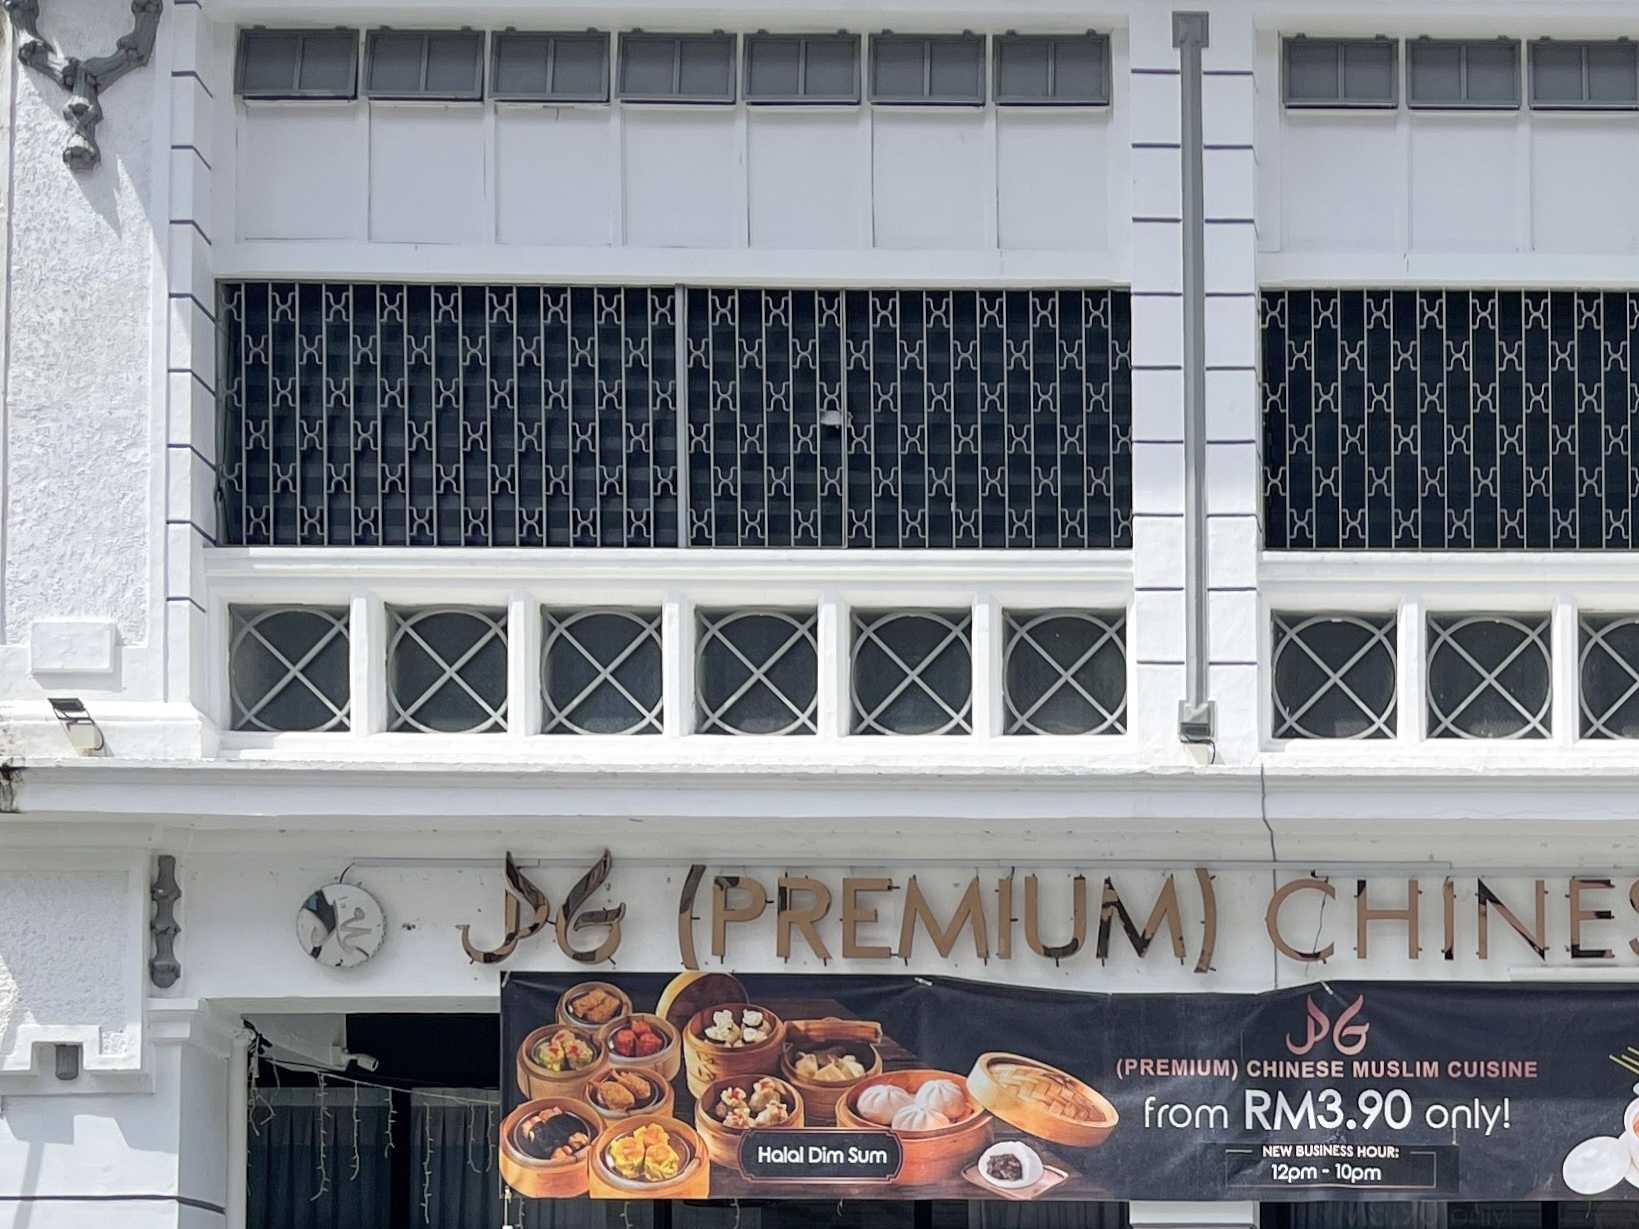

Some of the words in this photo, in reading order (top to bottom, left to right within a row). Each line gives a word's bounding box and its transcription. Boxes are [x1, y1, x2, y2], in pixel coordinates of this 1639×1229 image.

[678, 864, 1217, 974] (PREMIUM)
[1116, 1058, 1239, 1081] (PREMIUM)
[1246, 1060, 1345, 1079] CHINESE
[1352, 1060, 1440, 1079] MUSLIM
[1447, 1060, 1538, 1079] CUISINE
[1144, 1096, 1229, 1129] from
[1244, 1088, 1413, 1131] RM3.90
[1425, 1097, 1511, 1136] only!
[757, 1146, 804, 1164] Halal
[808, 1146, 844, 1164] Dim
[848, 1146, 888, 1164] Sum
[1262, 1145, 1294, 1158] NEW
[1295, 1144, 1354, 1158] BUSINESS
[1357, 1145, 1400, 1159] HOUR:
[1271, 1163, 1318, 1183] 12pm
[1334, 1162, 1382, 1183] 10pm
